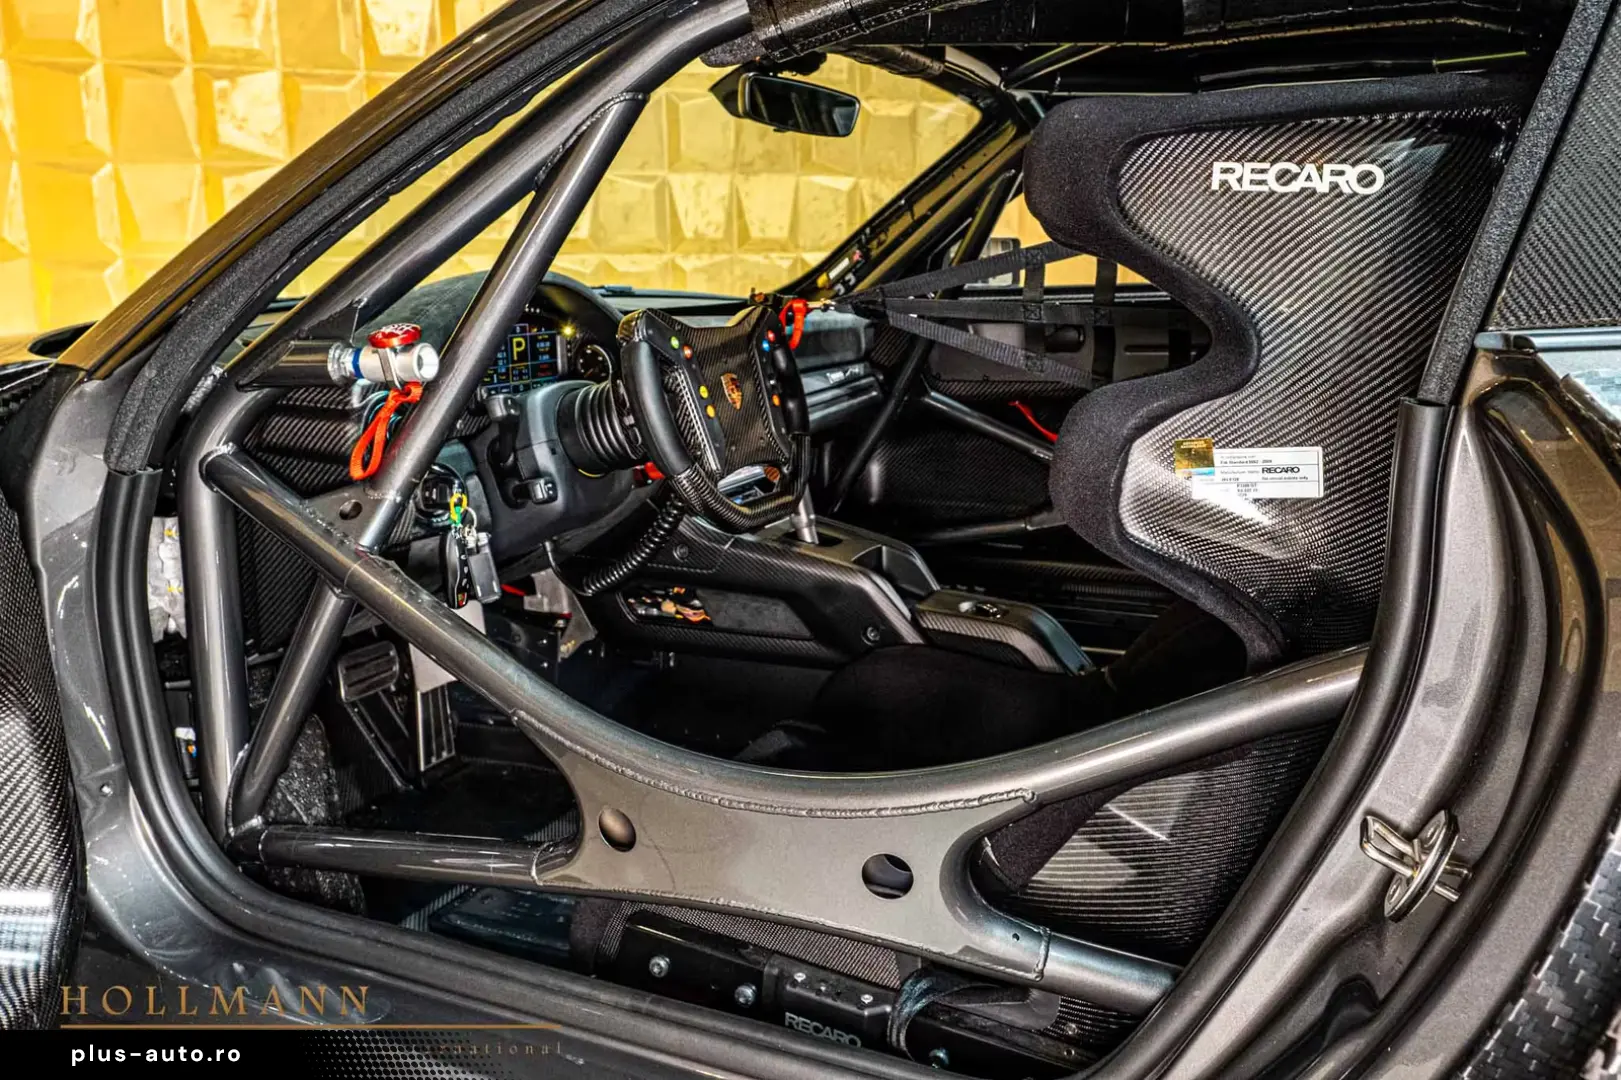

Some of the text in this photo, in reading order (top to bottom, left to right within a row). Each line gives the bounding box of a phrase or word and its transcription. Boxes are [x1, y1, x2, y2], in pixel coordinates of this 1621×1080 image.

[1211, 161, 1385, 195] RECARO
[512, 337, 526, 361] P
[1261, 466, 1300, 474] RECARO
[784, 1011, 862, 1048] RECARO
